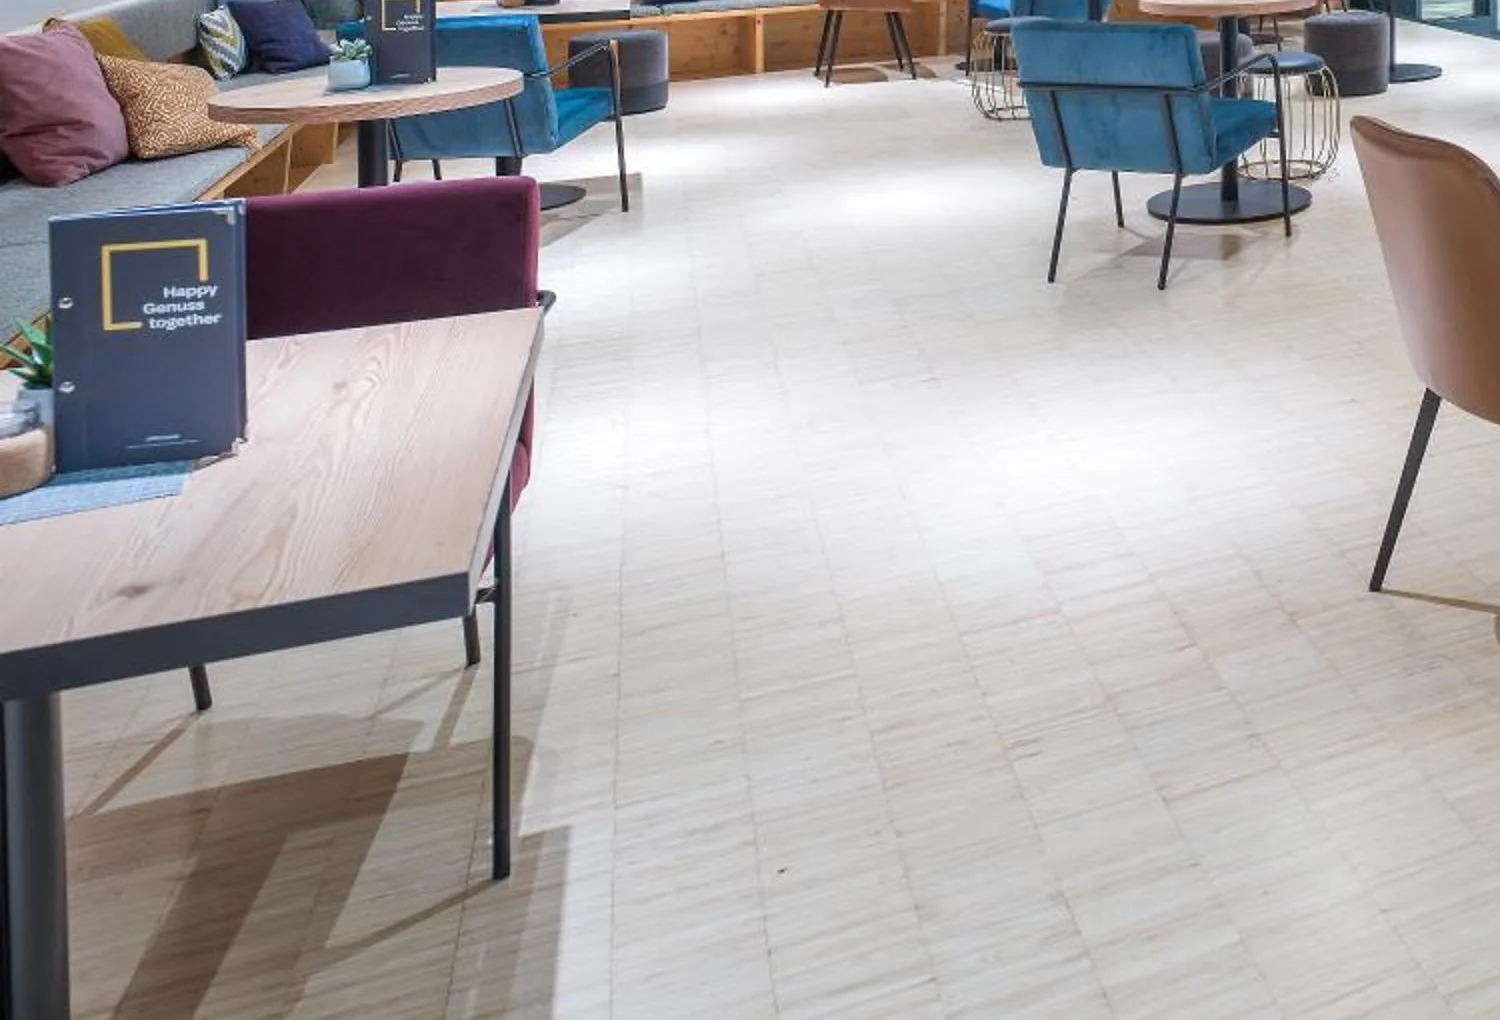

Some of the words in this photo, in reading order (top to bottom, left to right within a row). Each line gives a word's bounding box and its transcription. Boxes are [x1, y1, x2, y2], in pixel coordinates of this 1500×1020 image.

[163, 285, 218, 299] Happy
[143, 301, 205, 315] Genuss
[148, 313, 222, 330] together
